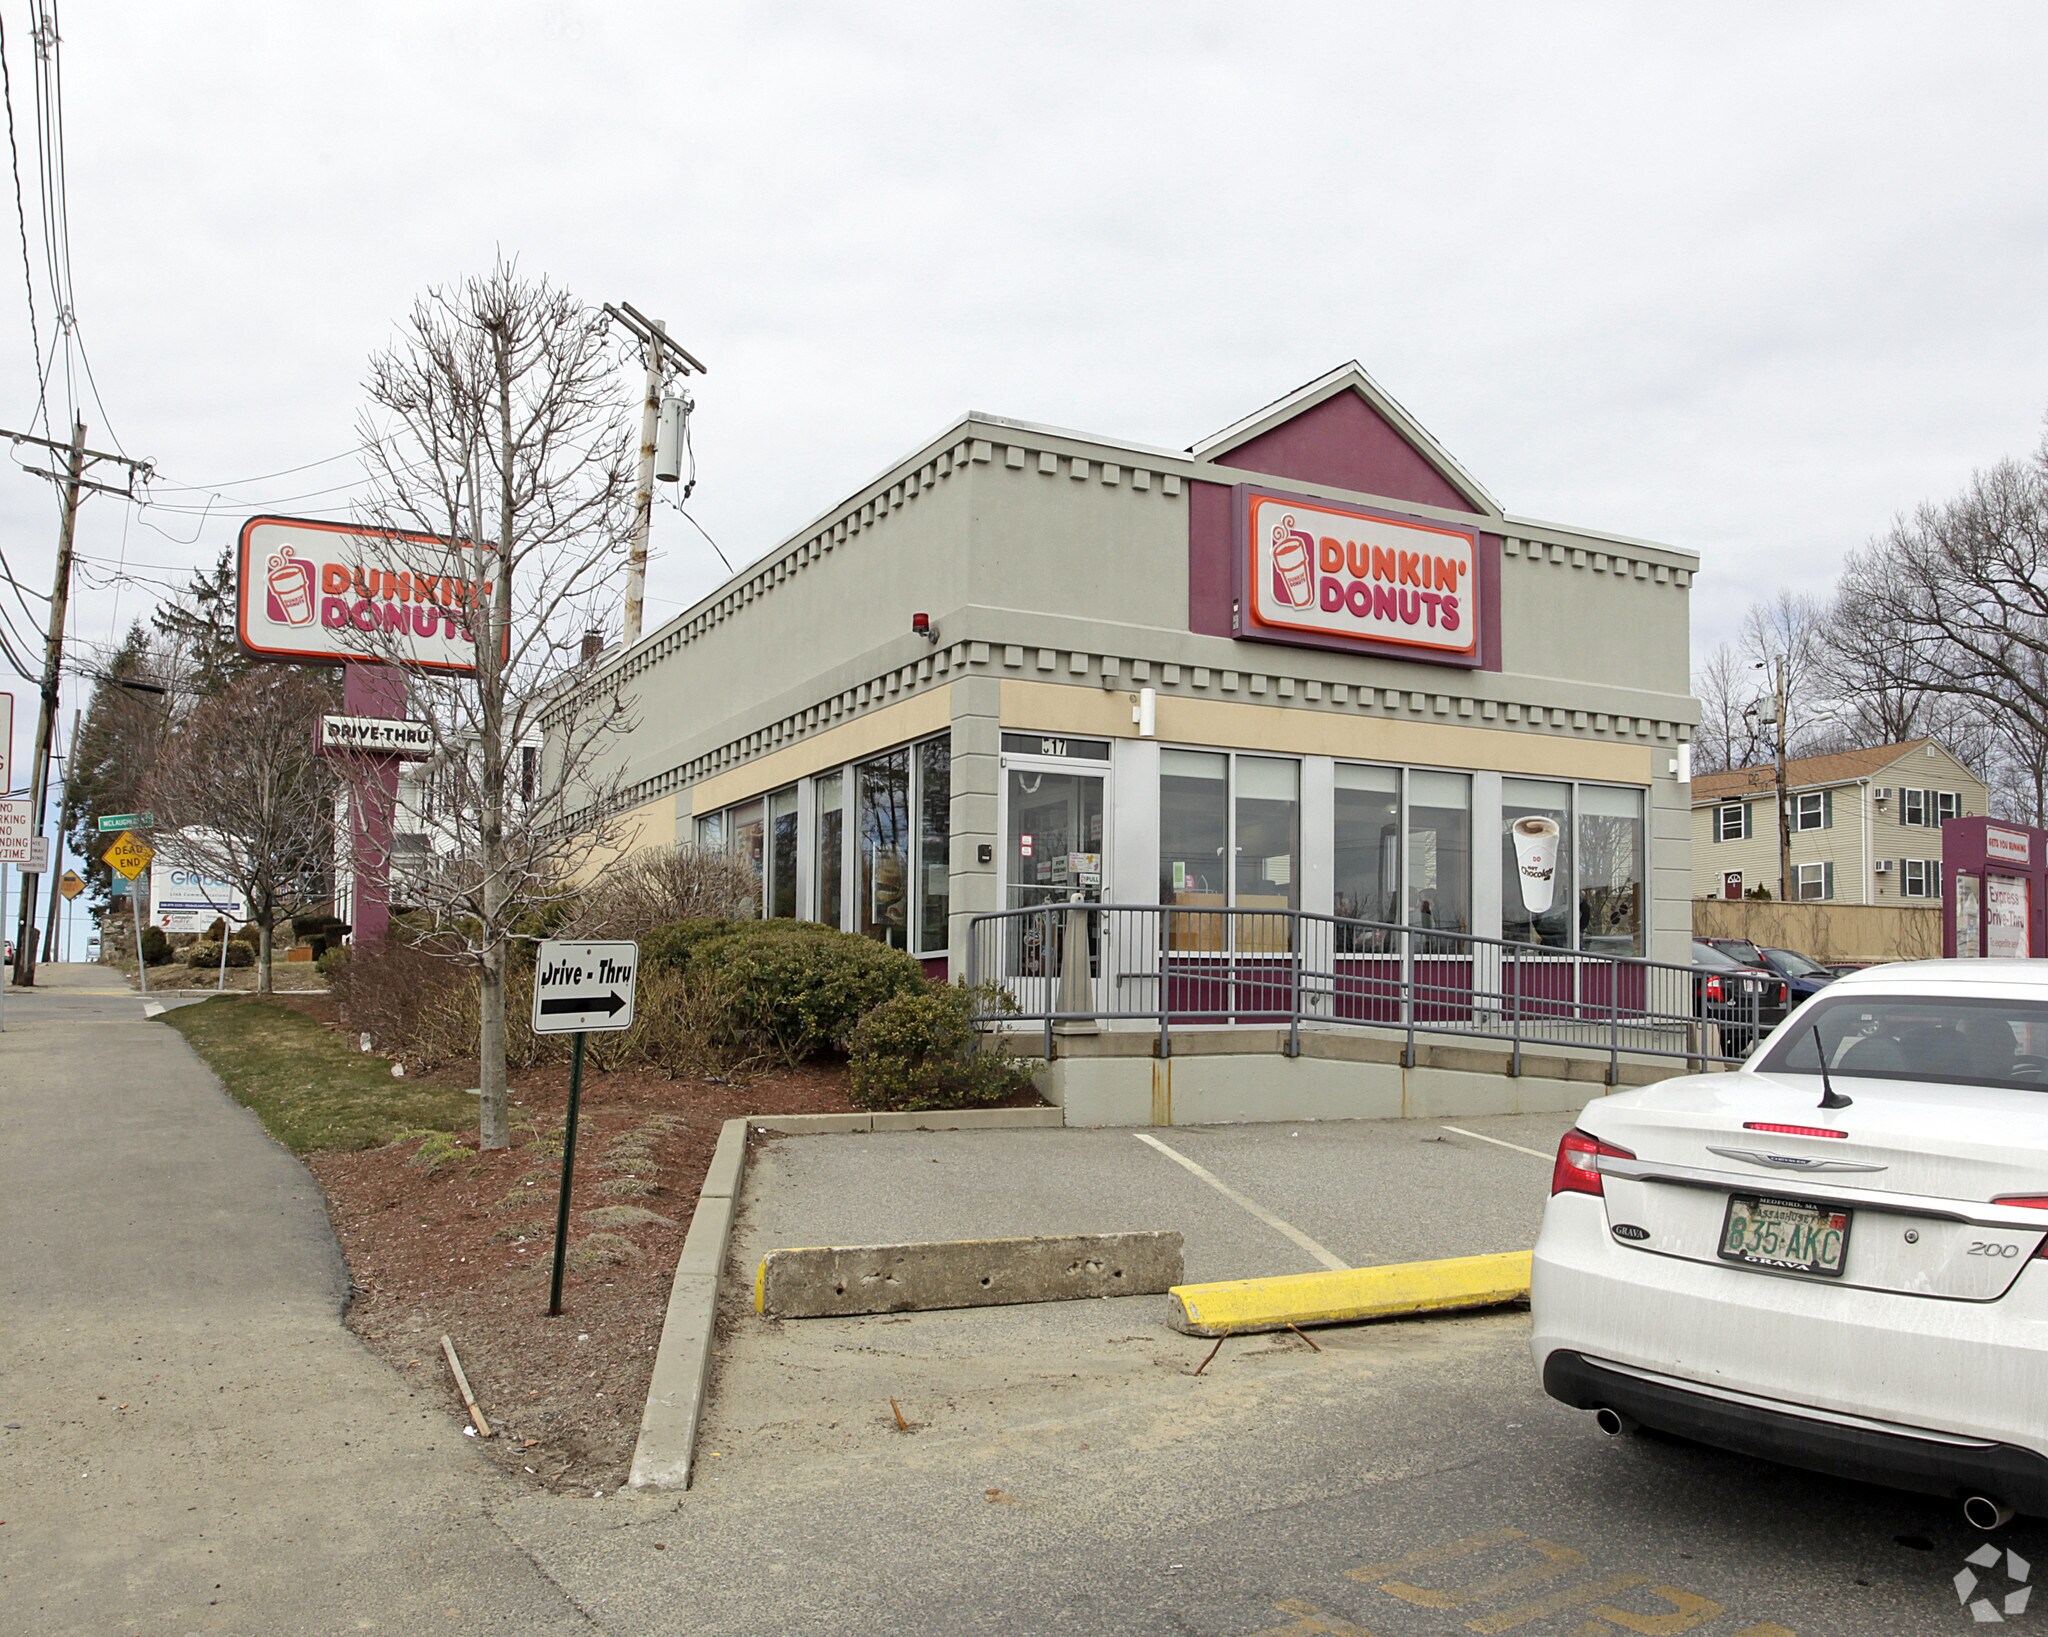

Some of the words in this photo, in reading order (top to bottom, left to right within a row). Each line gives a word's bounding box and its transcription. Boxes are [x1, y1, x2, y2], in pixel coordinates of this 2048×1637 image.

[1320, 536, 1467, 593] DUNKIN'
[1320, 576, 1461, 632] DONUTS
[328, 723, 428, 743] DRIVE-THRU
[0, 803, 13, 813] NO
[115, 845, 143, 856] DEAD
[120, 857, 140, 868] END
[1989, 886, 2019, 906] Express
[541, 959, 582, 986] Drive
[599, 958, 632, 984] Thru
[1754, 1207, 1828, 1226] ASSACHUSET
[1615, 1226, 1644, 1239] GRAVA
[1967, 1241, 2019, 1258] 200
[1744, 1256, 1810, 1271] GRAVA
